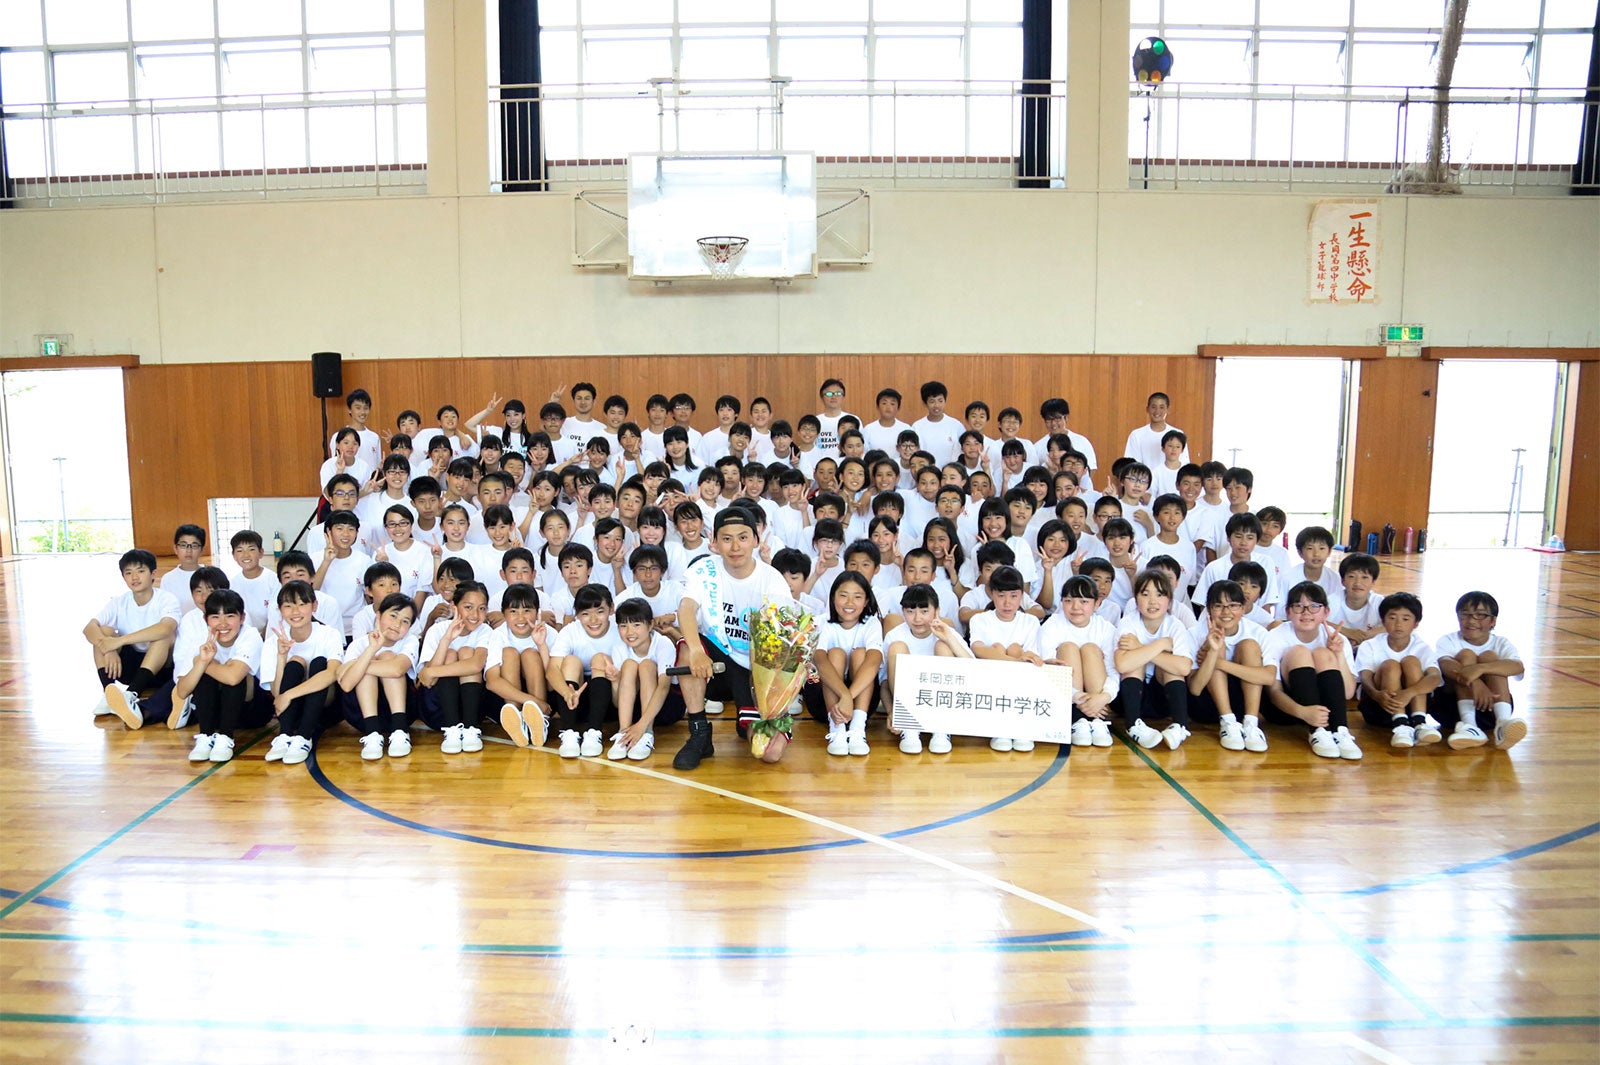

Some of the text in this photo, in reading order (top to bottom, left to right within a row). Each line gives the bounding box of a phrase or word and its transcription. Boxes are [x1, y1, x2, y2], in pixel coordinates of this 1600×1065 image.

[1347, 212, 1372, 302] 一生懸命
[918, 671, 966, 686] 長岡京市
[915, 688, 1052, 717] 長岡第四中学校
